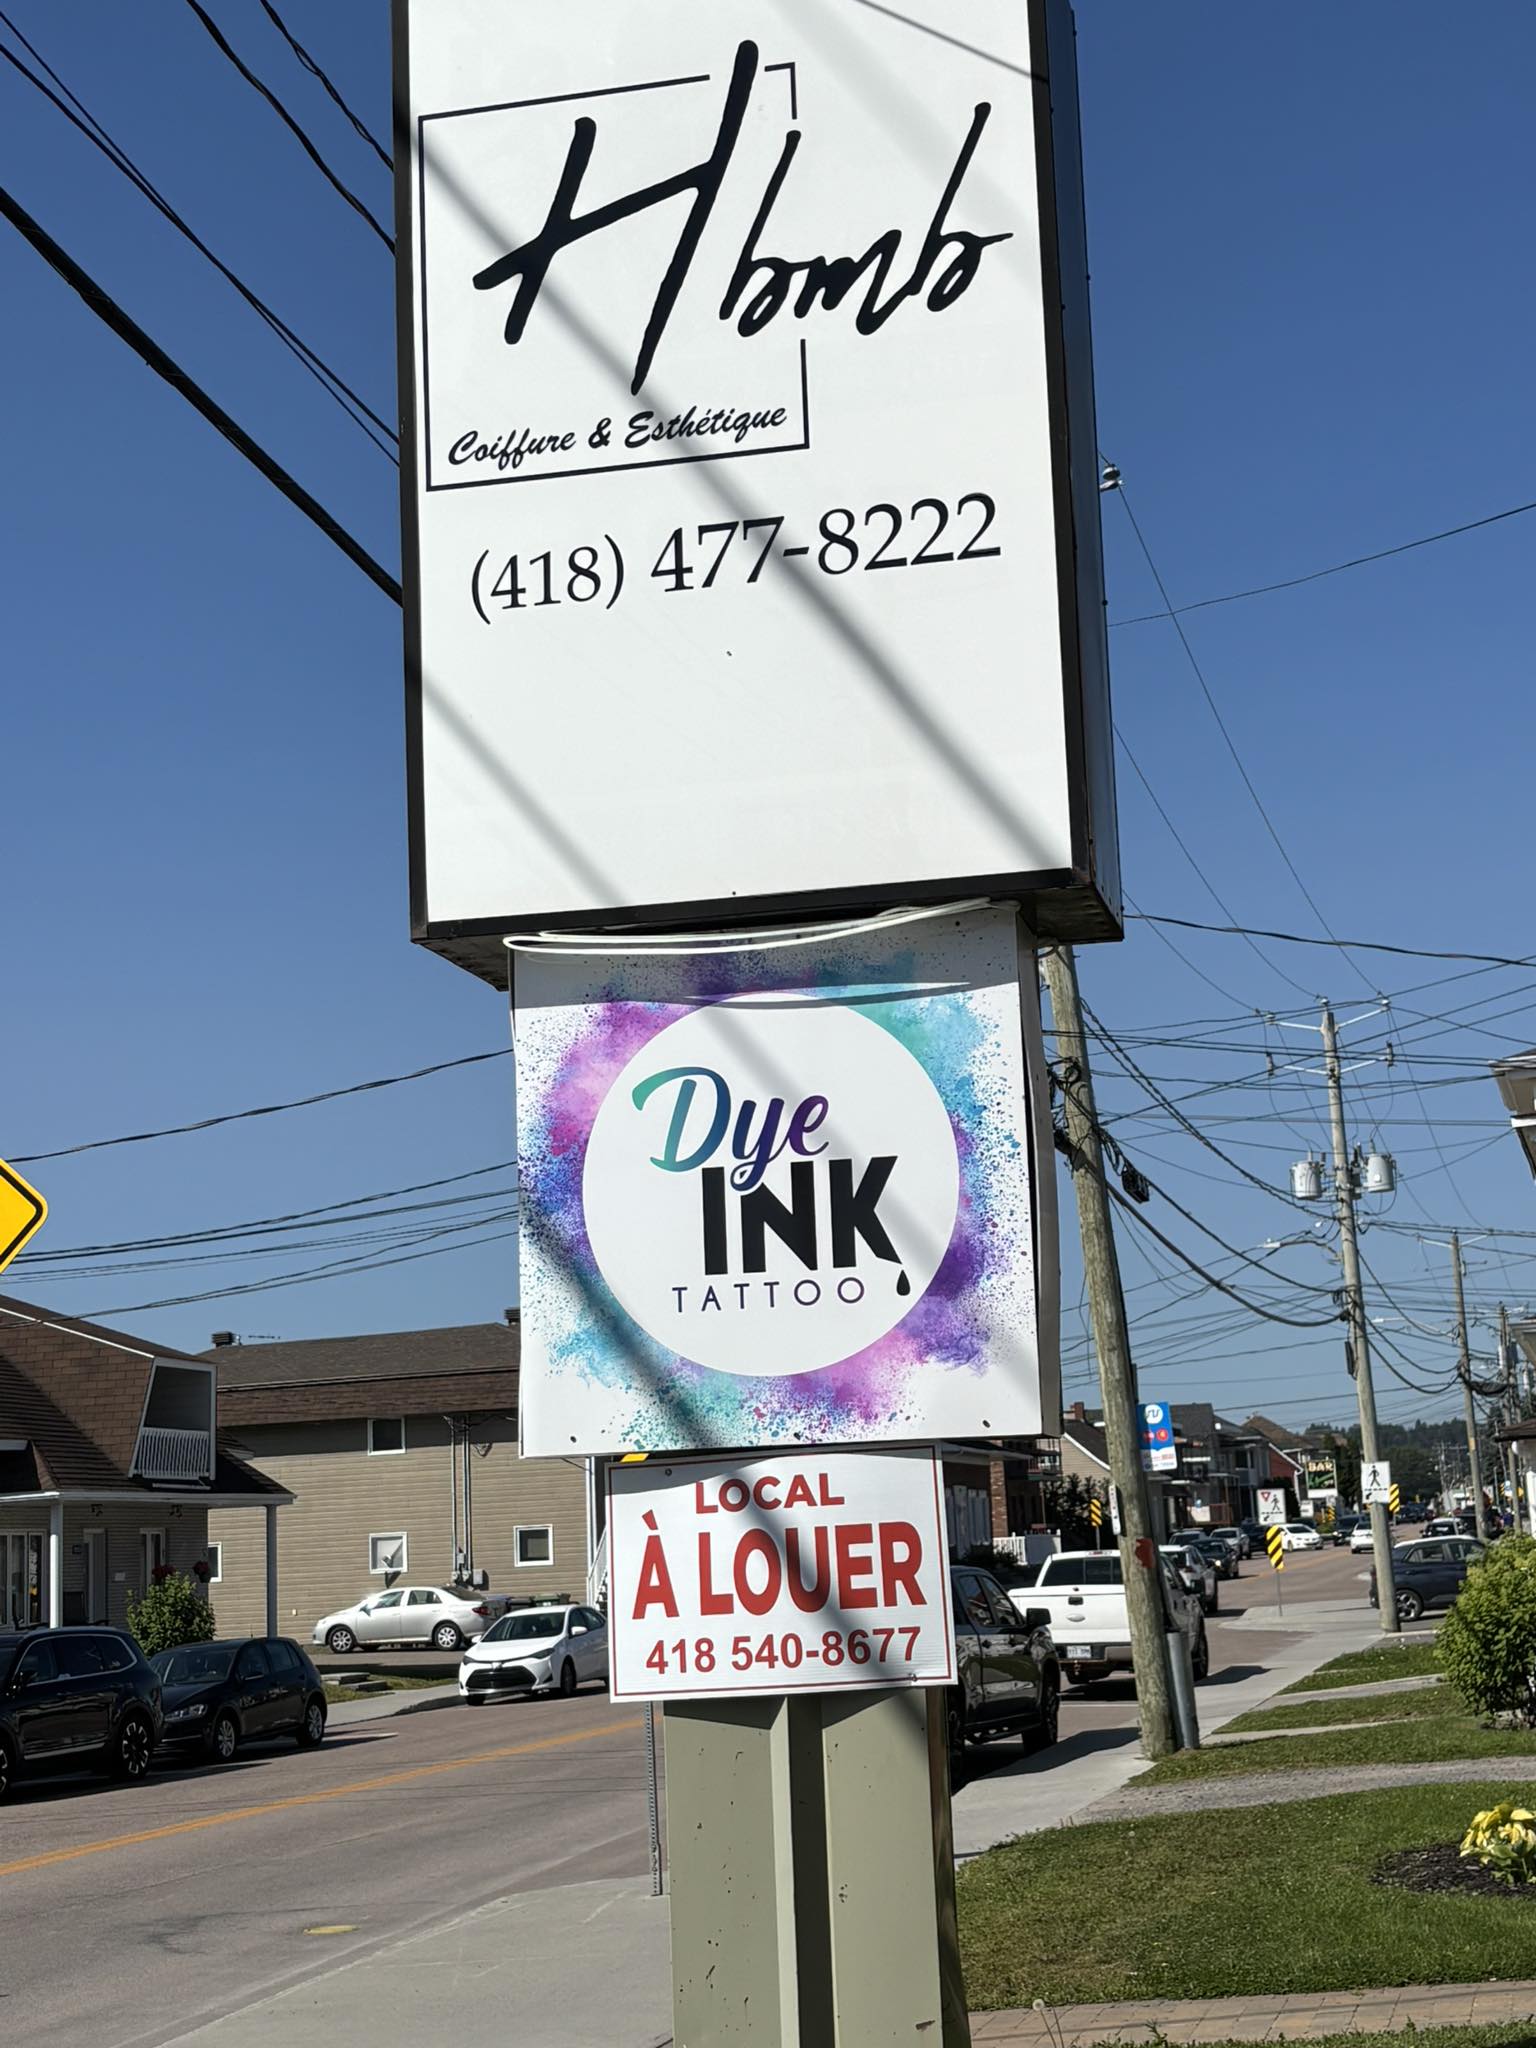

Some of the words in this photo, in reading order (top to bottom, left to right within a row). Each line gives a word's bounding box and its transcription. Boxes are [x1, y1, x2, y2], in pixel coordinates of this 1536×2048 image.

[448, 427, 576, 471] Coiffure
[588, 417, 611, 449] &
[624, 405, 787, 449] Esthétique
[471, 534, 625, 625] (418)
[651, 492, 1002, 593] 477-8222
[631, 1066, 829, 1192] Dye
[701, 1155, 903, 1276] INK
[672, 1277, 865, 1313] TATTOO
[695, 1473, 845, 1514] LOCAL
[1308, 1461, 1334, 1472] BAR
[632, 1509, 680, 1620] À
[698, 1521, 927, 1616] LOUER
[646, 1637, 716, 1675] 418
[731, 1626, 921, 1672] 540-8677
